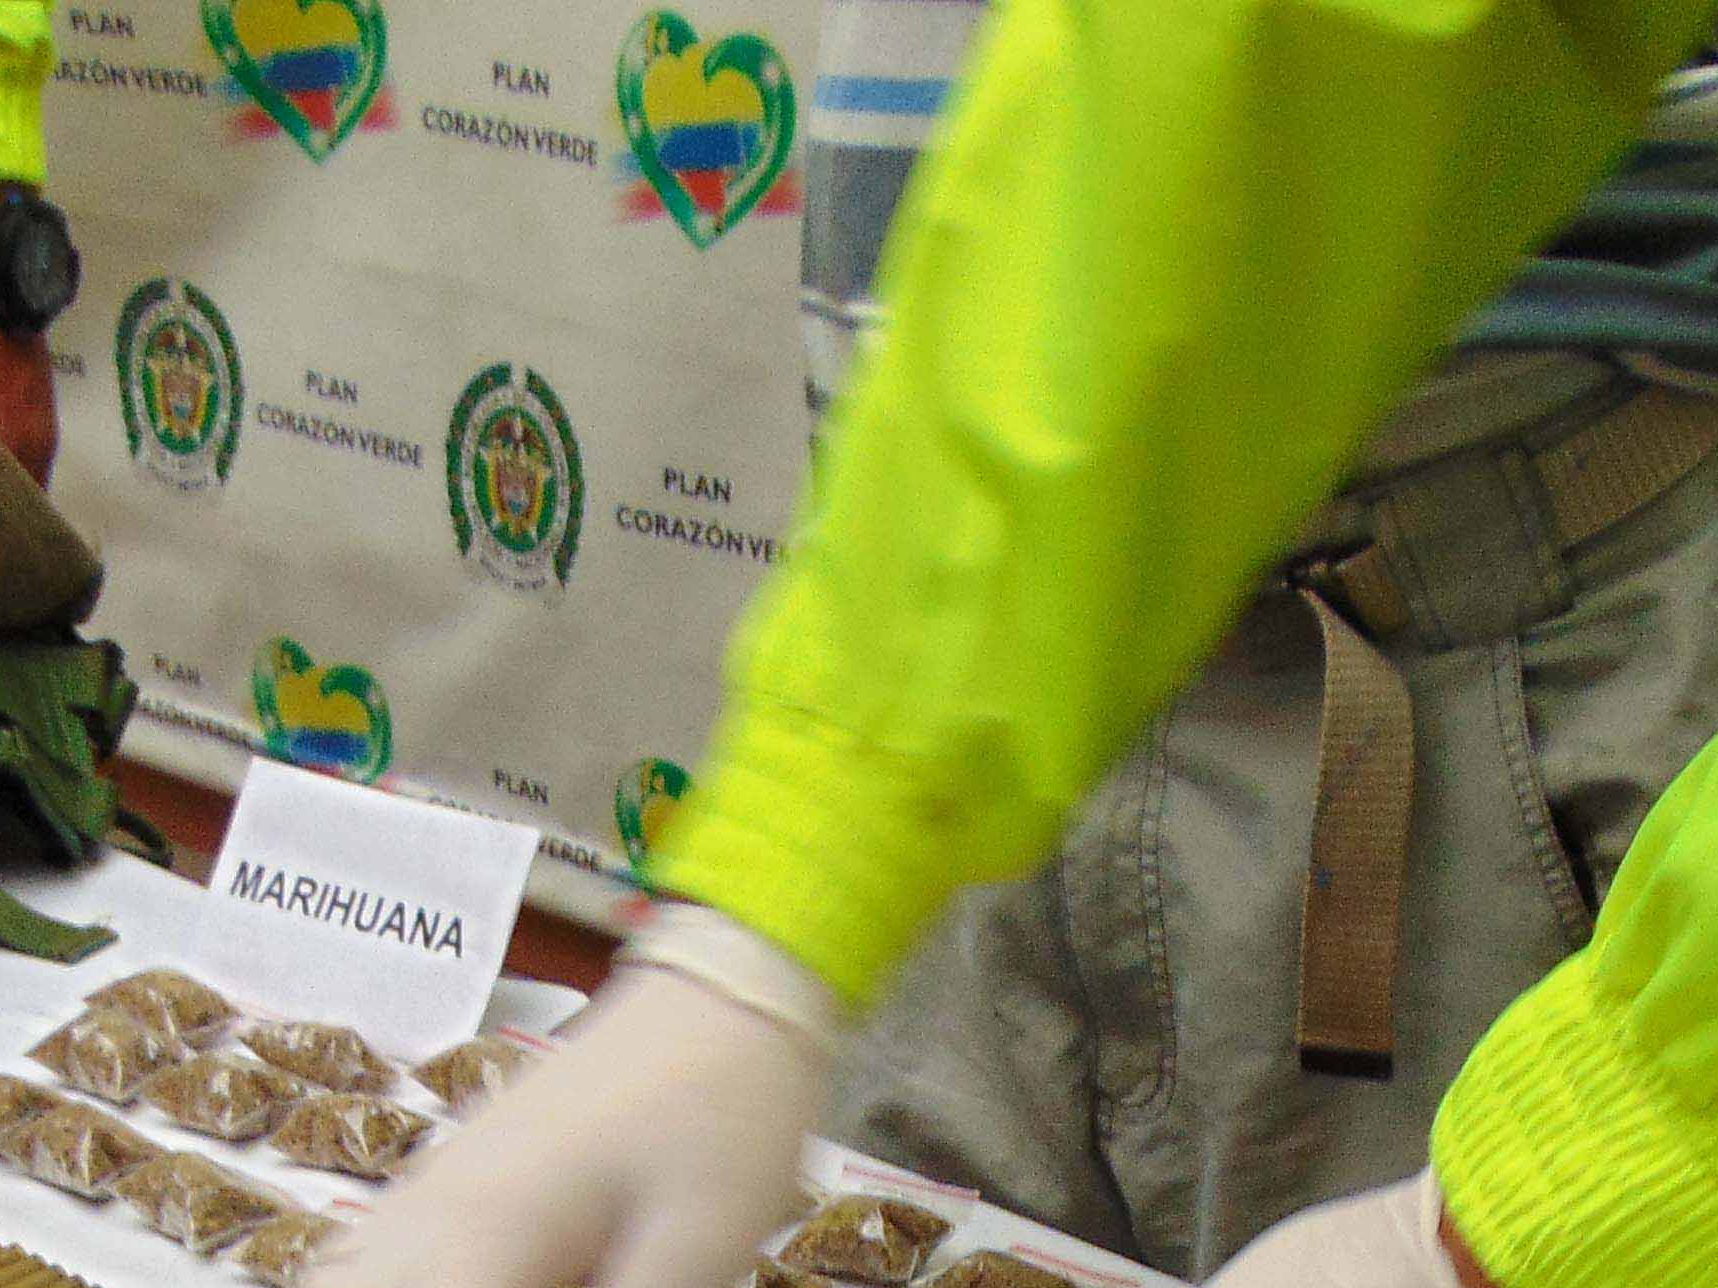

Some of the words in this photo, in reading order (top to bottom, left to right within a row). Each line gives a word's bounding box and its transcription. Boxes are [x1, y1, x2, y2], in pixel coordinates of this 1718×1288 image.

[492, 61, 550, 99] PLAN
[305, 368, 359, 403] PLAN
[663, 465, 732, 504] PLAN
[493, 768, 549, 805] PLAN
[229, 860, 464, 959] MARIHUANA
